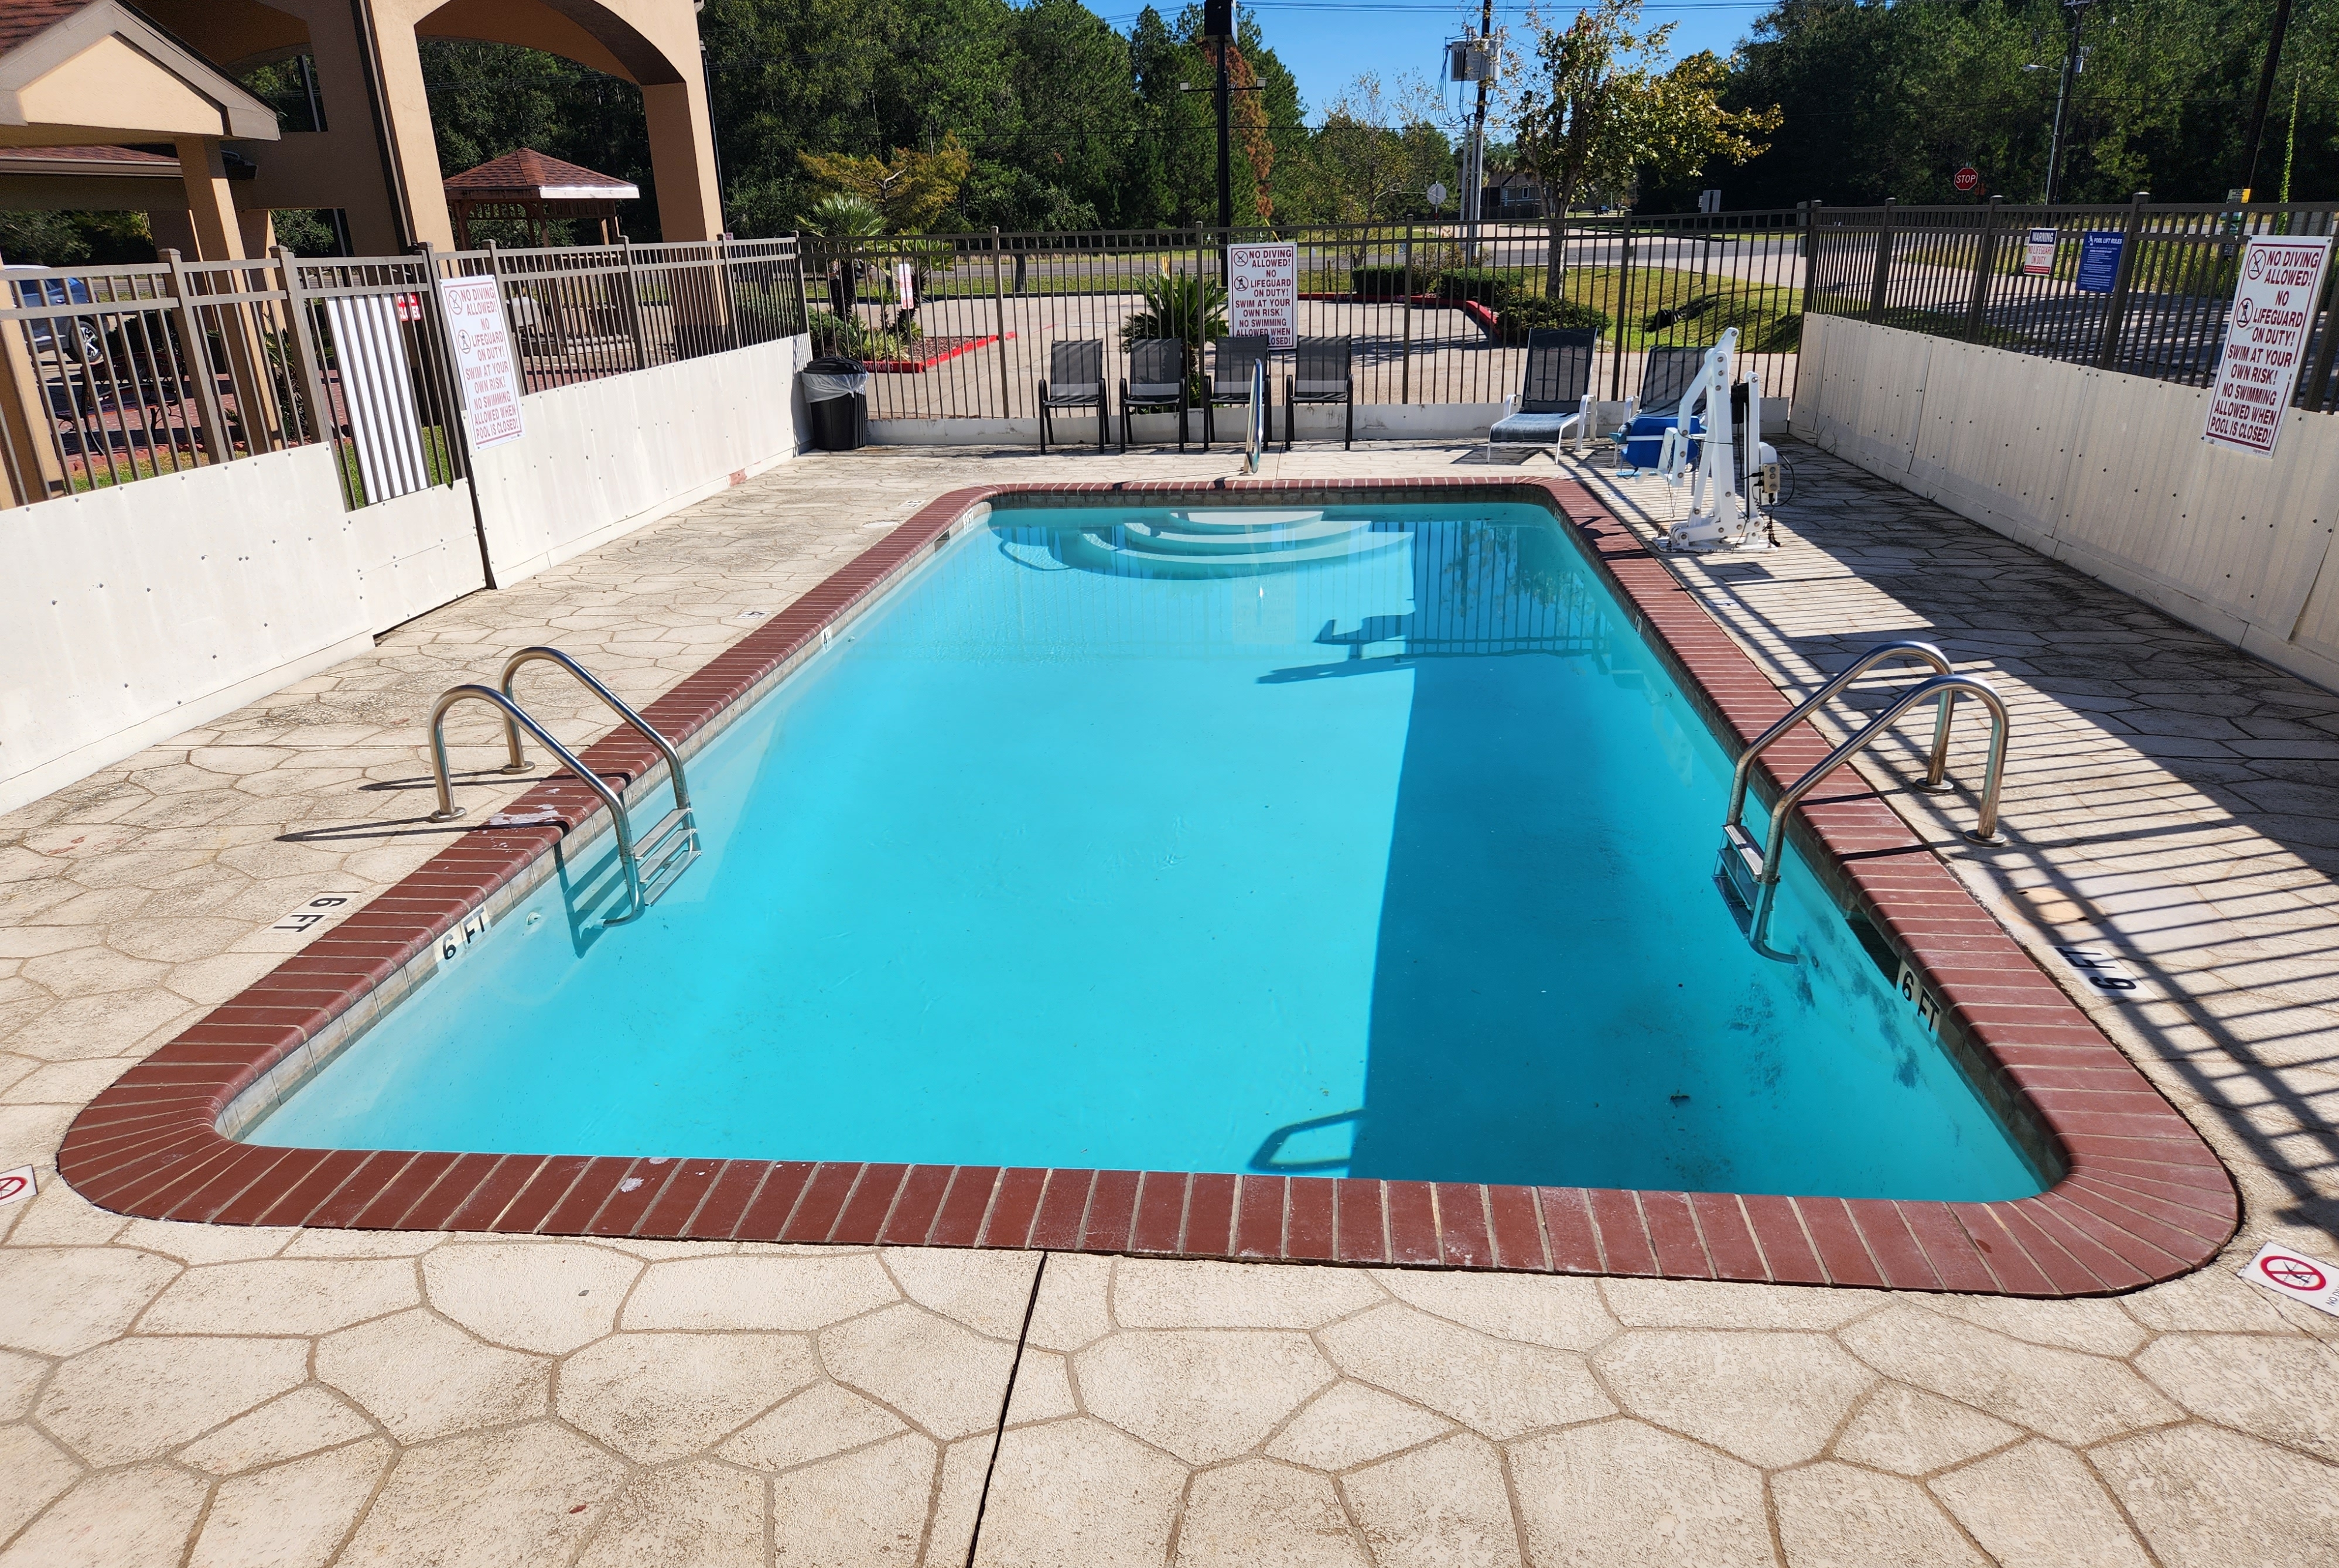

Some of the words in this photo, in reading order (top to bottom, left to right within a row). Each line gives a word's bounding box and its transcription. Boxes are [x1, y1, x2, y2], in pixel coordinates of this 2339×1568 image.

[1956, 175, 1976, 183] STOP
[2032, 232, 2054, 242] WARNING
[1249, 250, 1261, 258] NO
[1263, 250, 1292, 258] DIVING
[2266, 251, 2282, 266] NO
[2282, 251, 2319, 268] DIVING
[1252, 258, 1290, 268] ALLOWED!
[1266, 269, 1276, 278] NO
[2264, 269, 2314, 286] ALLOWED!
[1251, 279, 1291, 288] LIFEGUARD
[460, 289, 472, 302] NO
[472, 287, 495, 300] DIVING
[1266, 288, 1289, 296] DUTY!
[2275, 291, 2289, 306] NO
[467, 300, 497, 316] ALLOWED!
[1235, 300, 1255, 308] SWIM
[1257, 299, 1267, 308] AT
[1269, 299, 1290, 307] YOUR
[480, 317, 490, 330] NO
[1251, 319, 1286, 327] SWIMMING
[2252, 308, 2303, 327] LIFEGUARD
[471, 331, 504, 347] LIFEGUARD
[1236, 329, 1268, 337] ALLOWED
[1271, 327, 1290, 336] WHEN
[2252, 327, 2265, 343] ON
[2265, 328, 2296, 347] DUTY!
[477, 350, 487, 361] ON
[487, 346, 505, 359] DUTY!
[2228, 344, 2250, 361] SWIM
[2250, 348, 2264, 363] AT
[2265, 349, 2292, 368] YOUR
[465, 365, 483, 380] SWIM
[484, 364, 491, 377] AT
[492, 361, 509, 374] YOUR
[2231, 363, 2251, 380] OWN
[2251, 367, 2278, 385] RISK!
[474, 380, 489, 394] OWN
[490, 376, 506, 390] RISK!
[474, 397, 482, 411] NO
[483, 391, 511, 408] SWIMMING
[2221, 382, 2234, 398] NO
[2235, 384, 2277, 406] SWIMMING
[474, 409, 499, 426] ALLOWED
[499, 404, 517, 418] WHEN
[2214, 399, 2250, 420] ALLOWED
[2251, 406, 2277, 426] WHEN
[476, 425, 490, 440] POOL
[491, 423, 496, 436] IS
[497, 418, 519, 434] CLOSED!
[2210, 416, 2228, 434] POOL
[2229, 421, 2238, 436] IS
[2238, 423, 2272, 444] CLOSED!
[309, 897, 348, 907] 6
[272, 914, 325, 932] FT
[442, 933, 456, 960] 6
[462, 906, 486, 944] FT
[2054, 947, 2116, 969] FT
[2088, 976, 2137, 990] 6
[1902, 971, 1914, 1002] 6
[1917, 988, 1940, 1033] FT
[2325, 1296, 2338, 1307] NO
